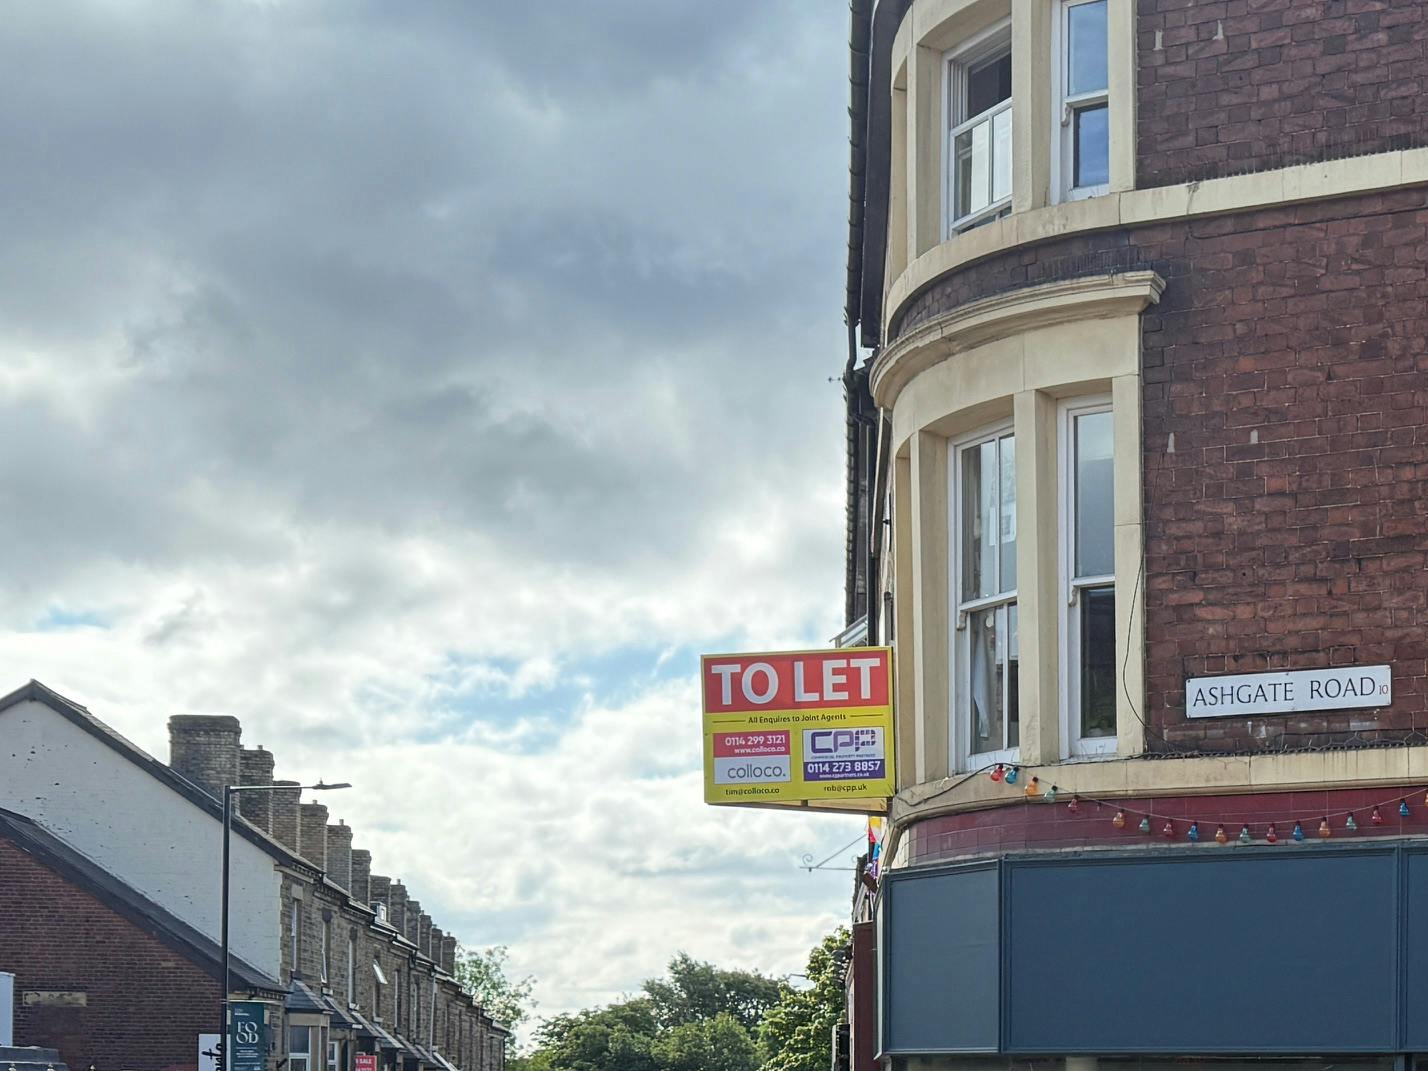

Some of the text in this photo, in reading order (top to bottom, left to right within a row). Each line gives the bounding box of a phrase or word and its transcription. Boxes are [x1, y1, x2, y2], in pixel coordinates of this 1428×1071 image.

[711, 658, 881, 705] TO LET
[1193, 677, 1389, 707] ASHGATE ROAD 10
[748, 716, 758, 724] All
[759, 715, 791, 724] Enquires
[801, 714, 819, 722] Joint
[821, 713, 846, 722] Agents
[725, 735, 786, 746] 0114 299 3121
[807, 761, 881, 773] 0114 273 8857
